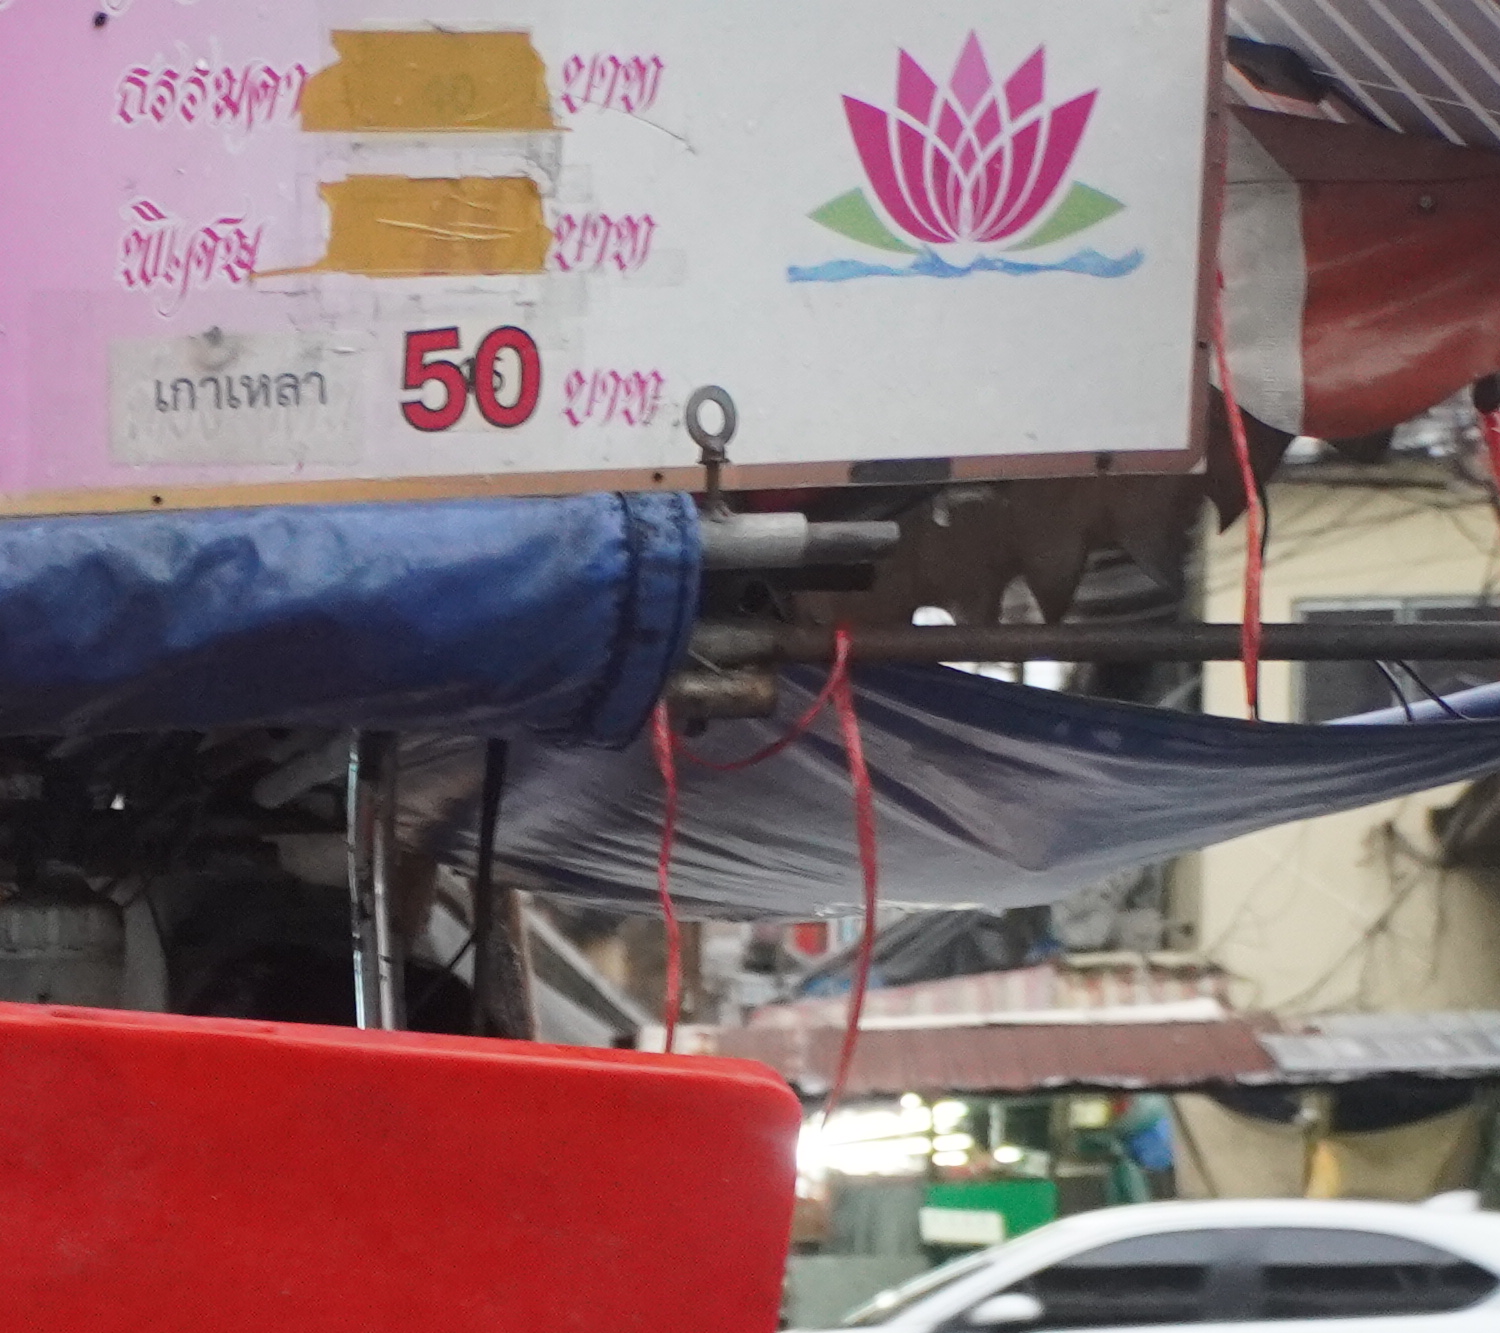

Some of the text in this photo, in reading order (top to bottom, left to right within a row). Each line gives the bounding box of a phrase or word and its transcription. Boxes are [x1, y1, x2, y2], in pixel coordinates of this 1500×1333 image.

[113, 58, 310, 135] ธรรมดา
[558, 53, 665, 114] บาท
[120, 198, 658, 305] พิเศษ บาท
[153, 325, 666, 432] เกาเหลา 50 บาท
